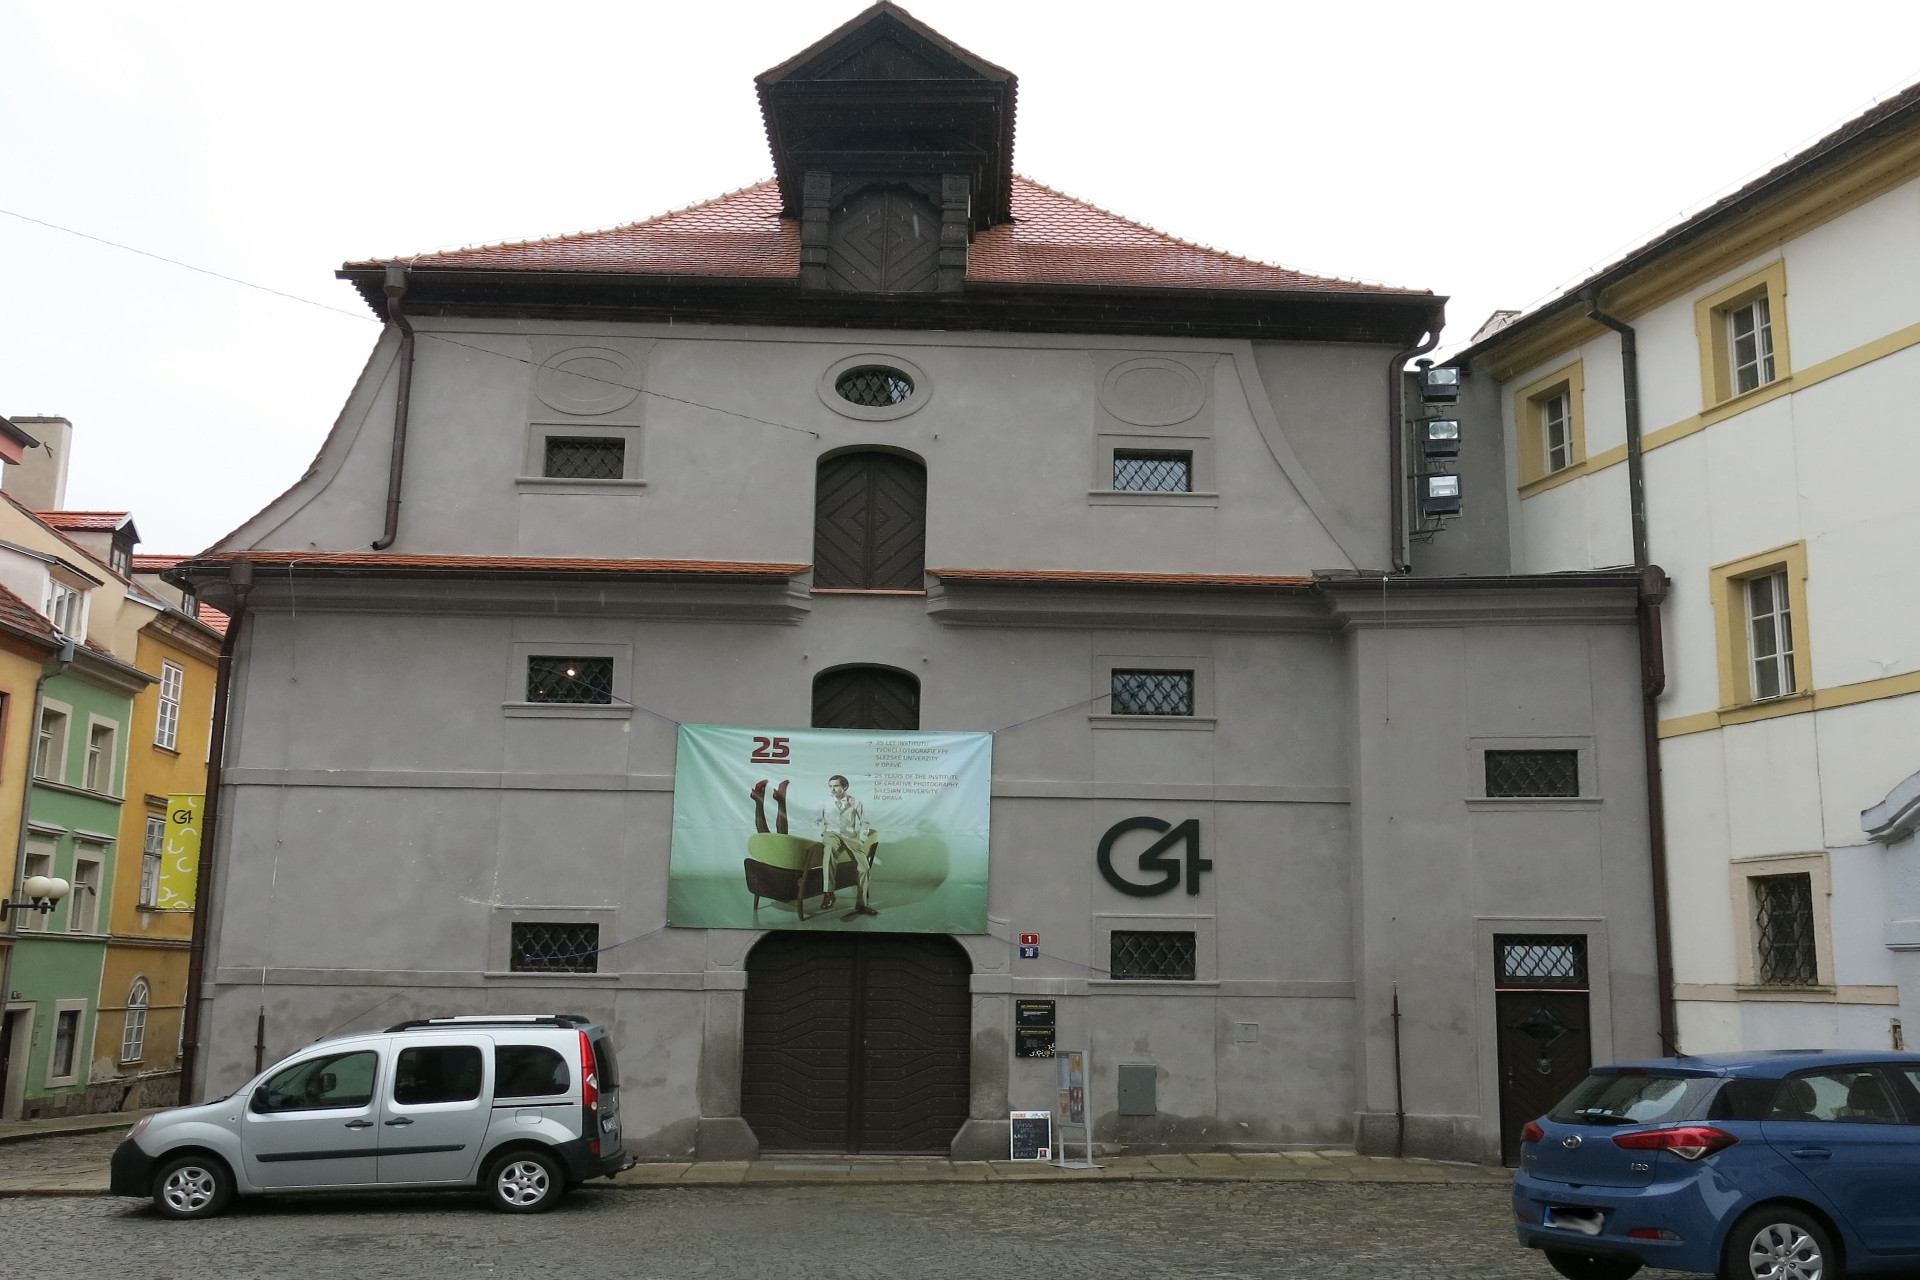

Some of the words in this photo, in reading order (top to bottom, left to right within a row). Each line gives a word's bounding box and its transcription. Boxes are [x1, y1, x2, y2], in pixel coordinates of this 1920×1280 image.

[752, 736, 790, 758] 25
[172, 809, 194, 825] G4
[1097, 816, 1213, 897] G4
[1027, 935, 1032, 943] 1
[1631, 1162, 1649, 1171] i20
